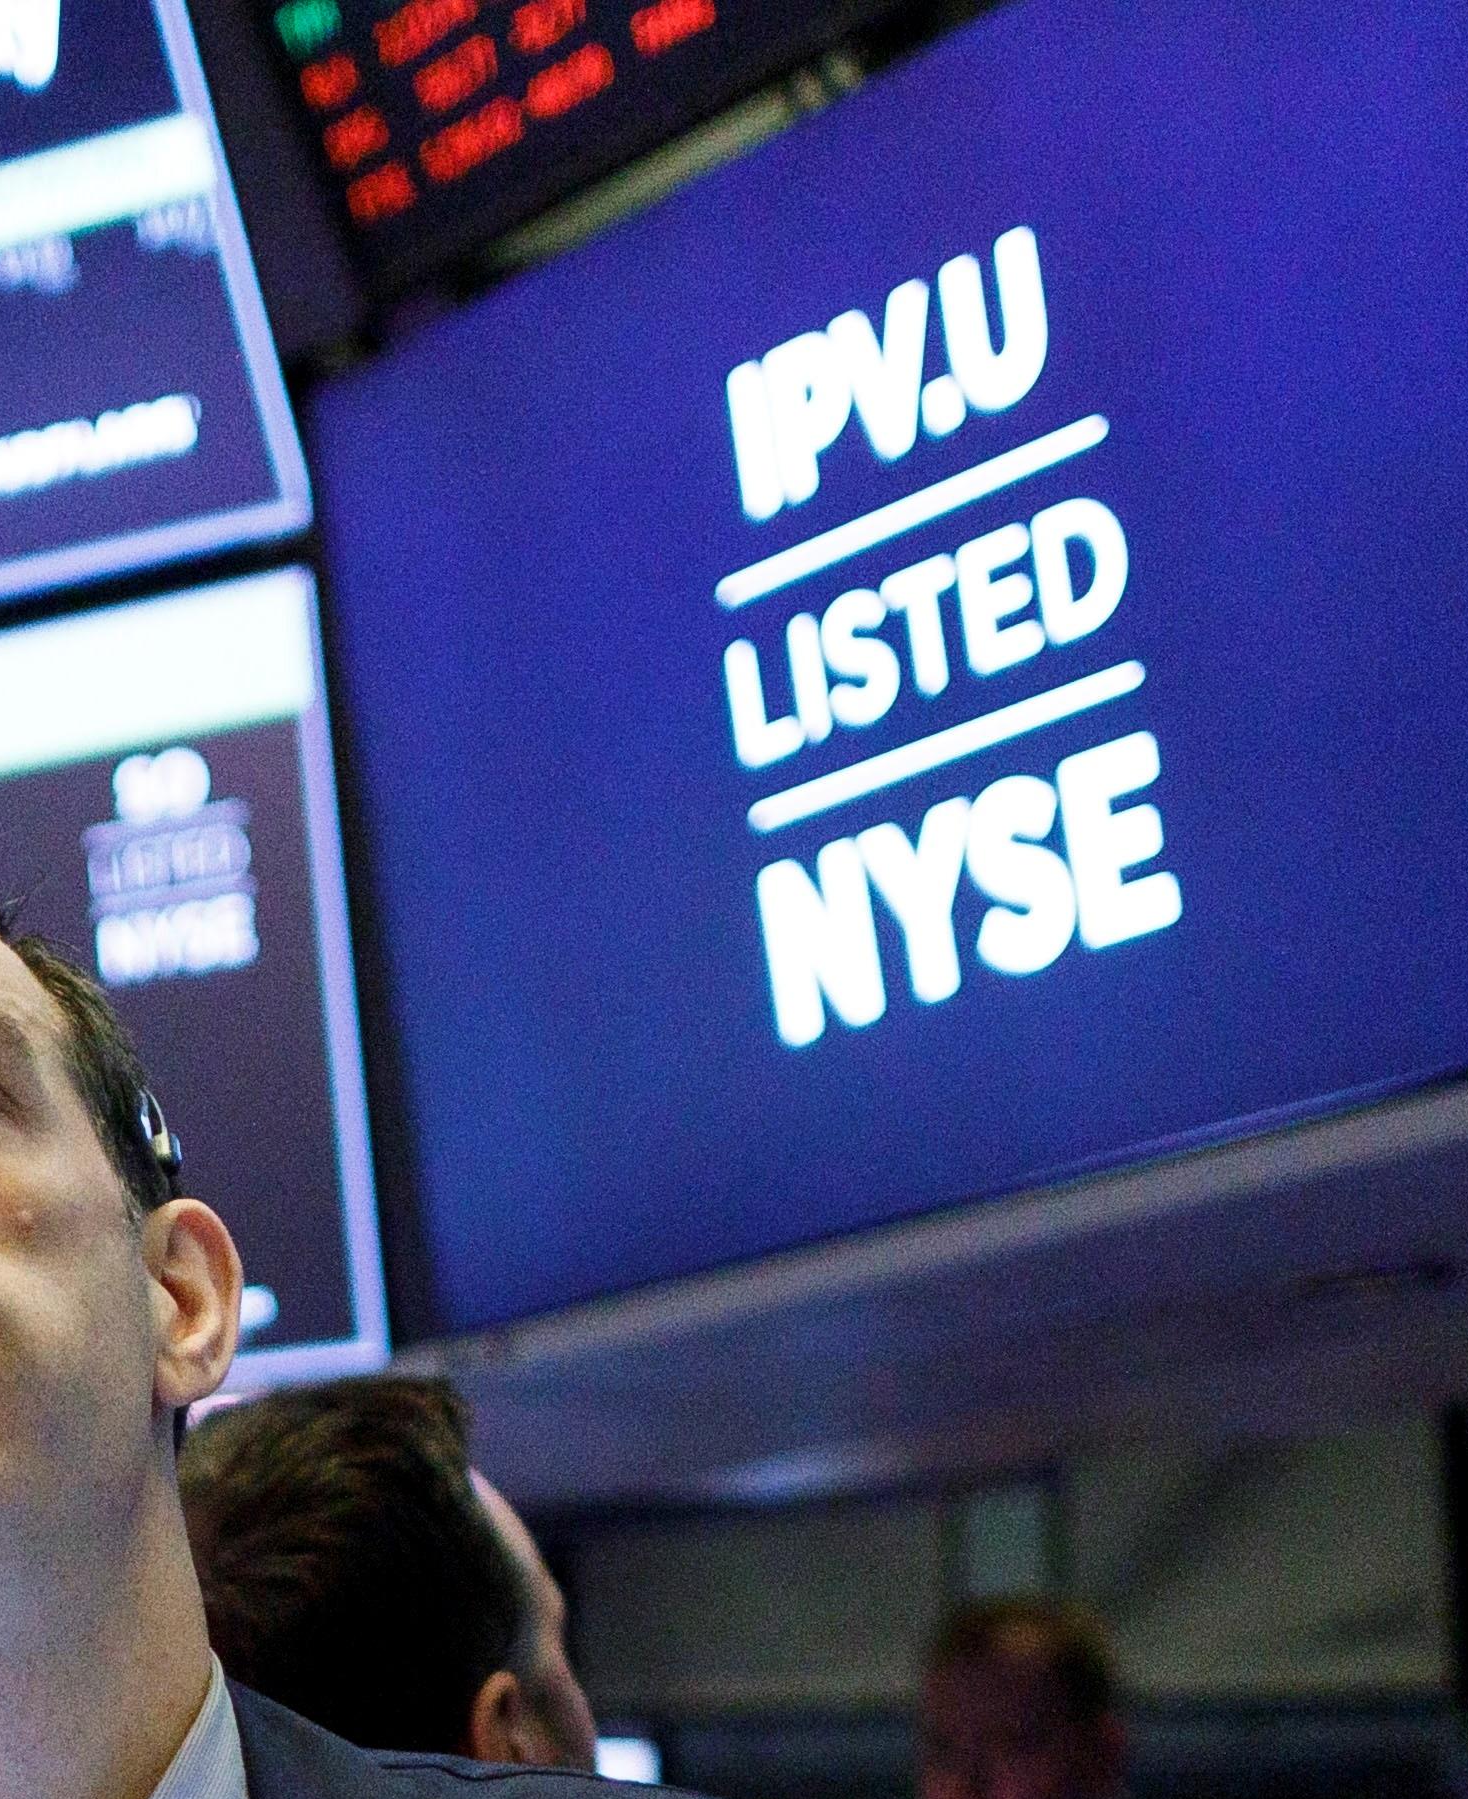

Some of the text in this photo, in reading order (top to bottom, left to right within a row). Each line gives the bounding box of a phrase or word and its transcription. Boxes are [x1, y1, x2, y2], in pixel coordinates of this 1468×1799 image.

[725, 224, 1050, 523] IPV.U
[722, 496, 1130, 771] LISTED
[756, 730, 1183, 1050] NYSE
